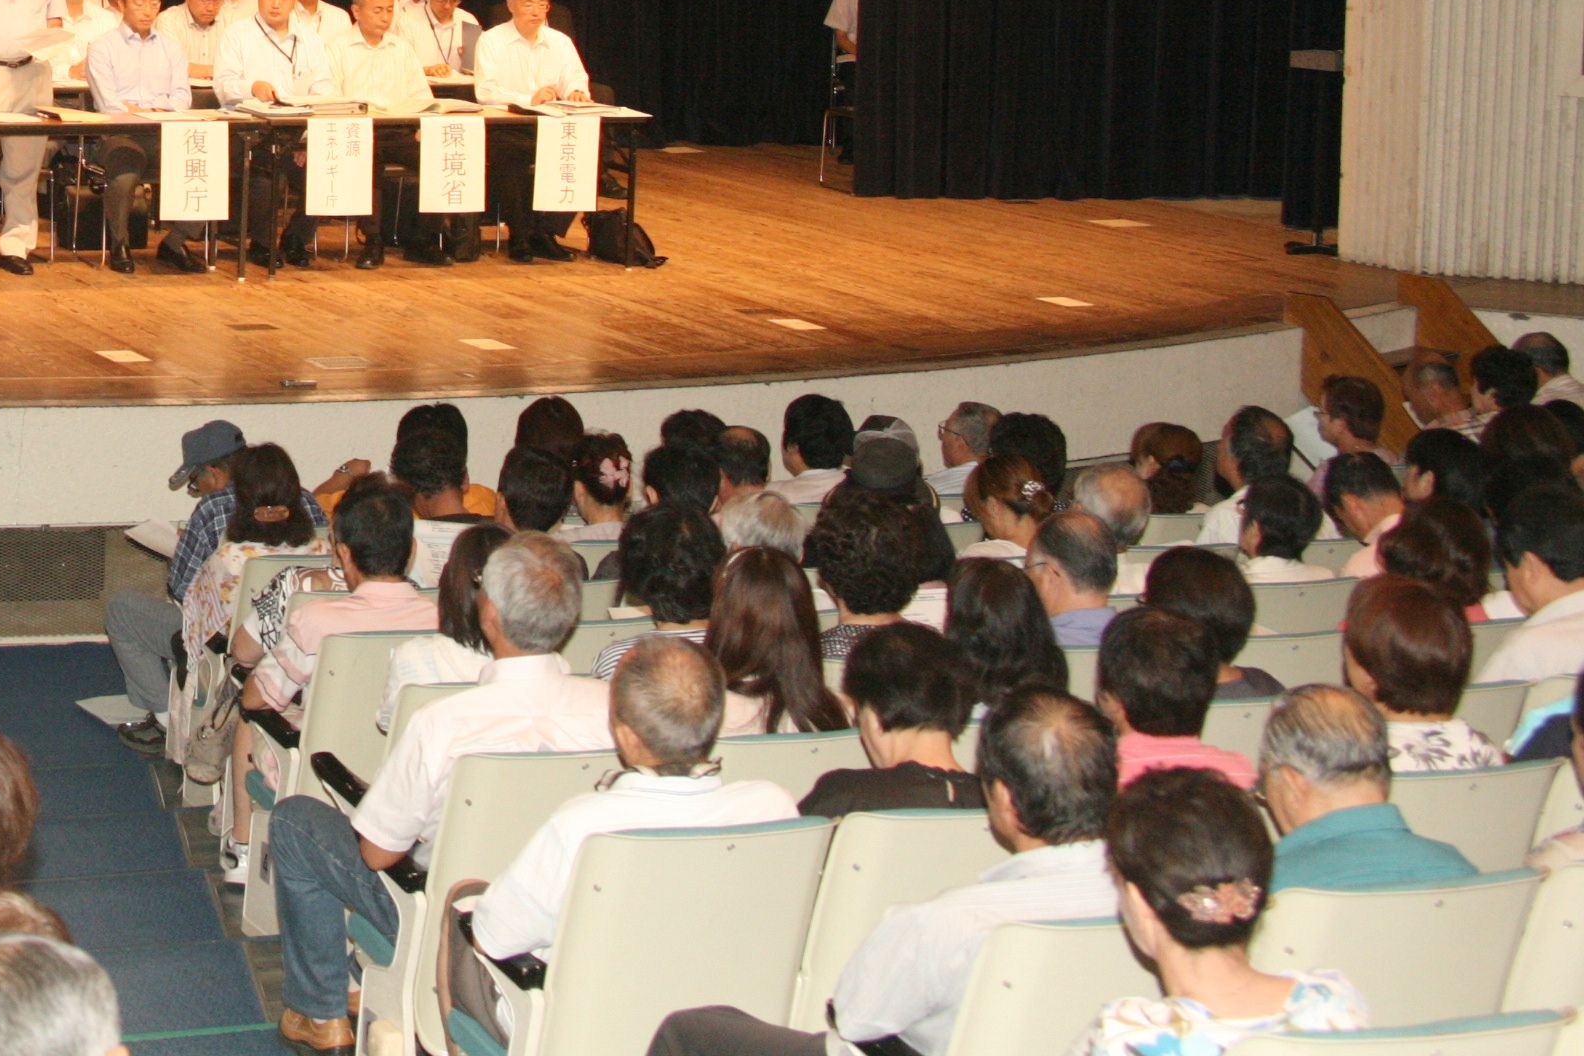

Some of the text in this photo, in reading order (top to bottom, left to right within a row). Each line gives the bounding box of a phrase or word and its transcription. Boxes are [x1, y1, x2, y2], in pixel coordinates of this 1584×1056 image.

[183, 128, 209, 213] 復興庁
[325, 122, 339, 208] エネルギー庁
[345, 122, 361, 157] 資源
[441, 122, 466, 206] 環境省
[558, 120, 577, 204] 東京電力
